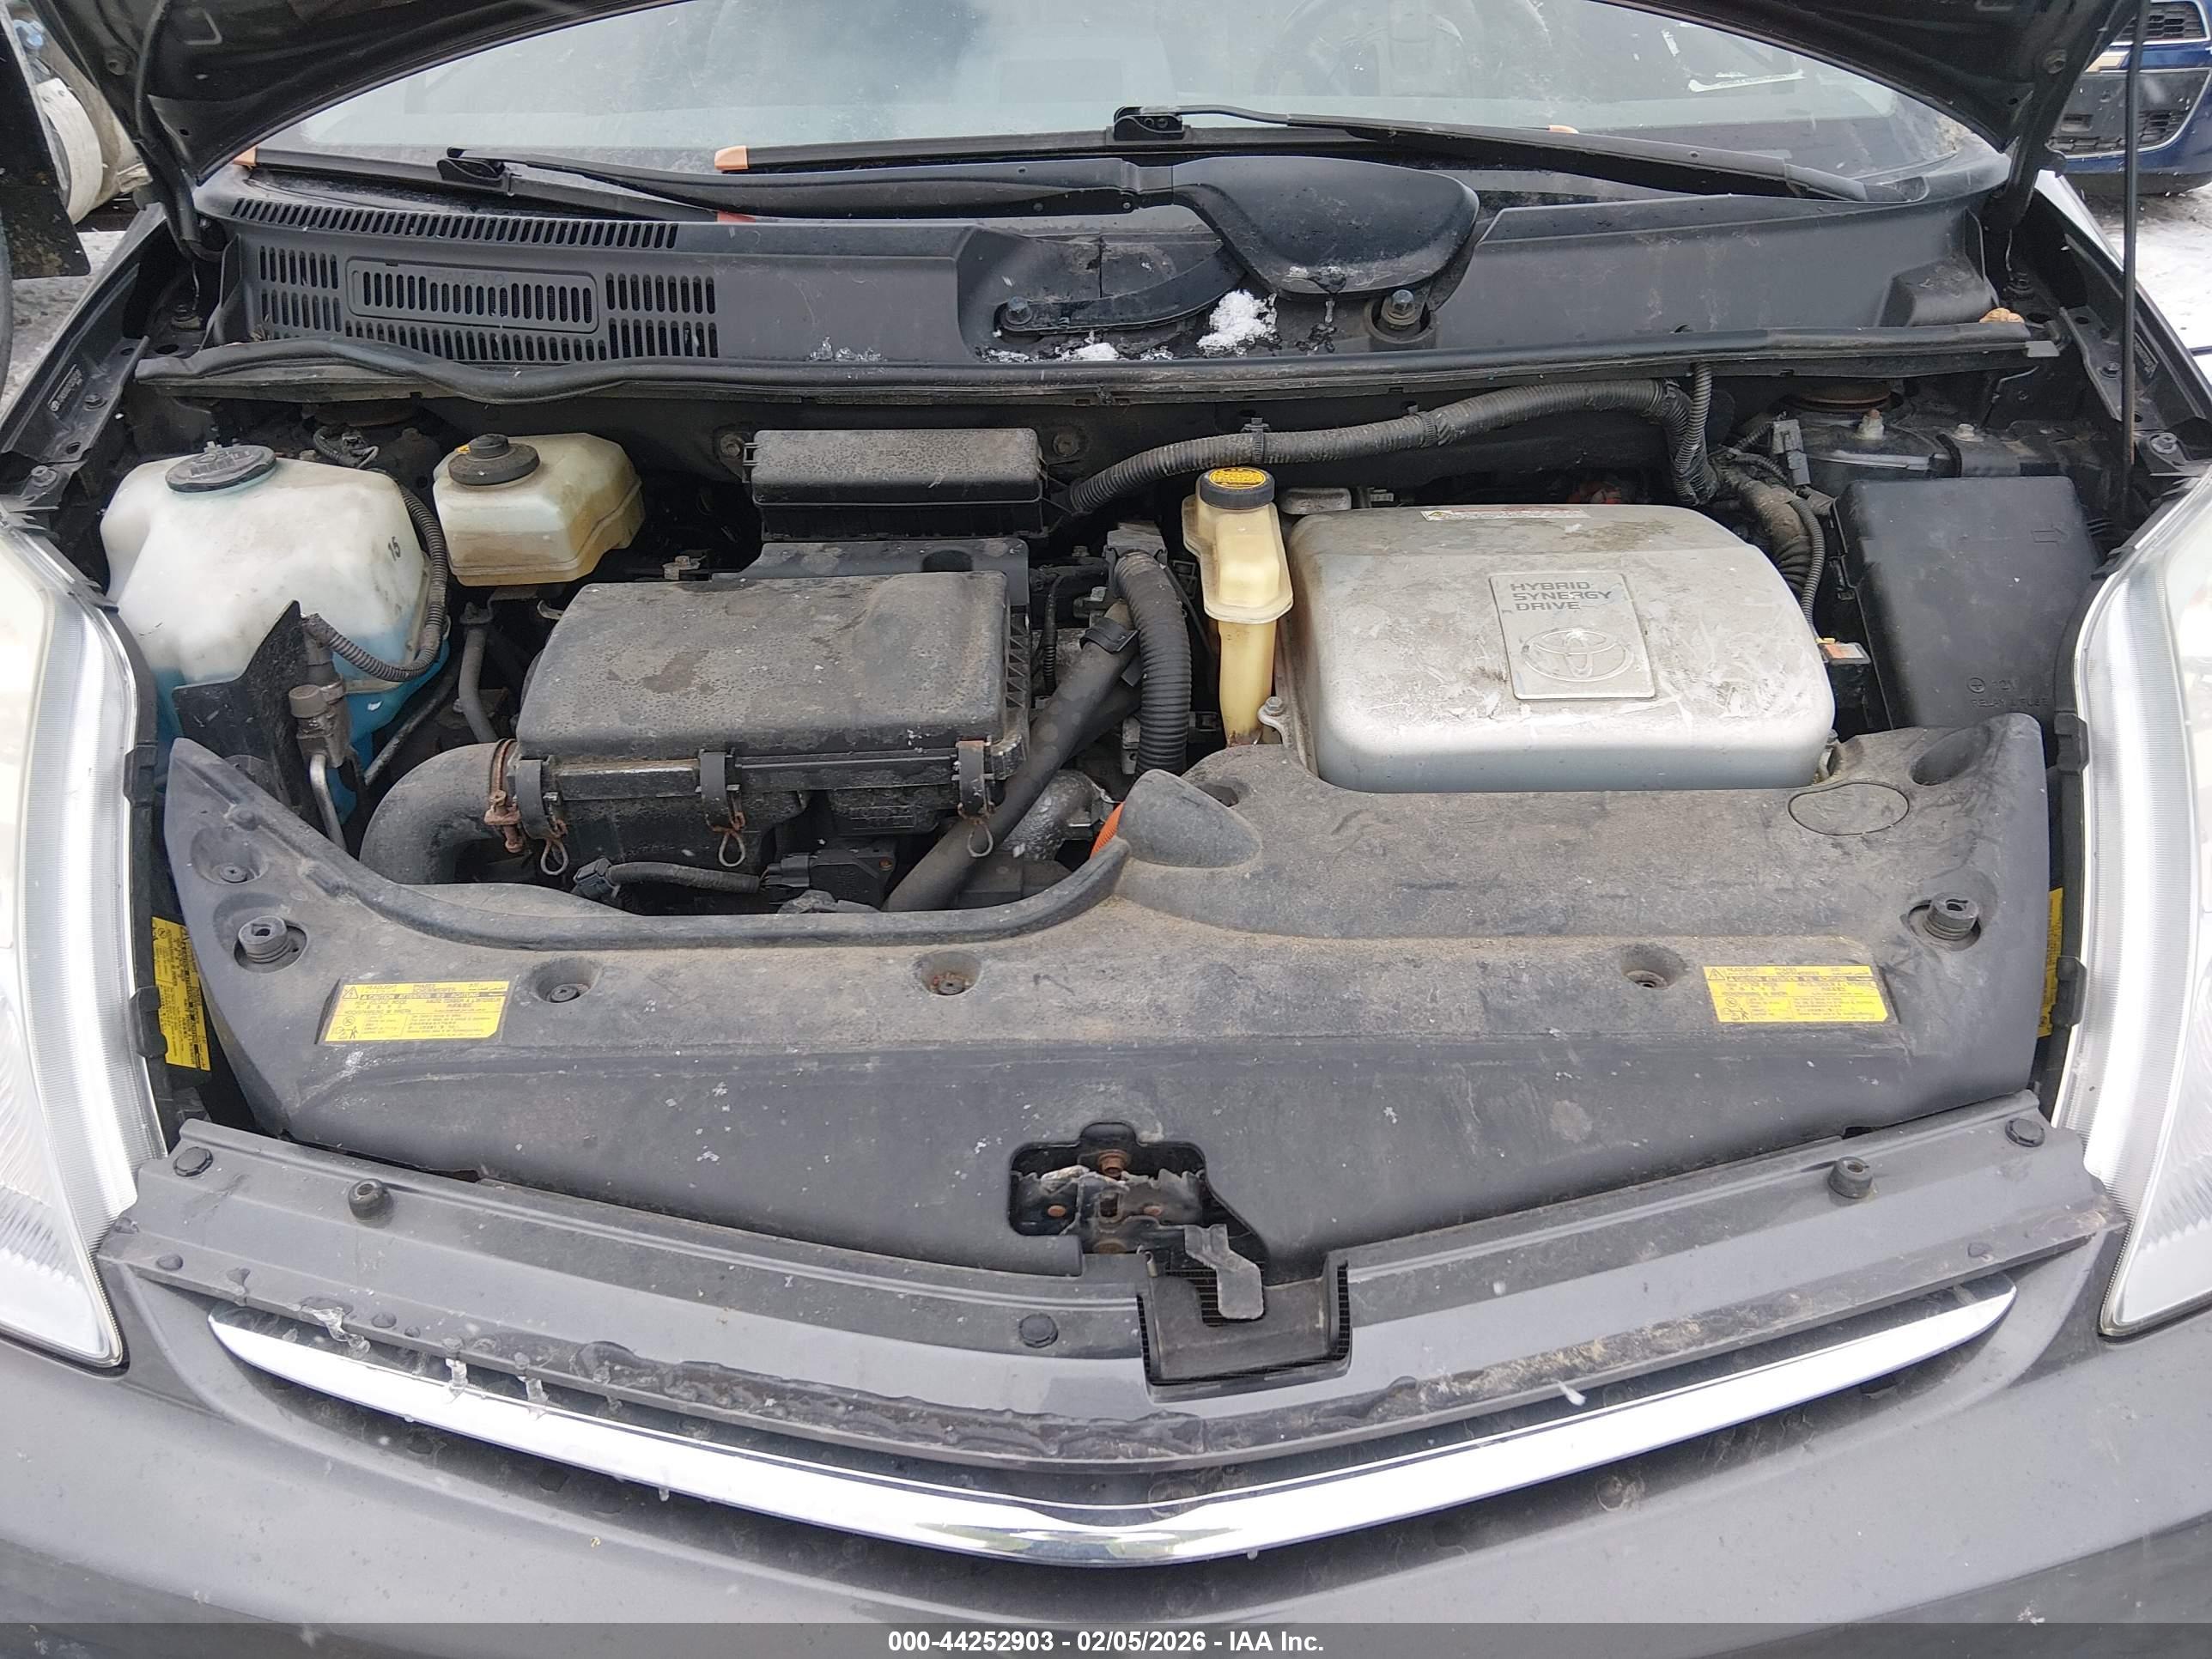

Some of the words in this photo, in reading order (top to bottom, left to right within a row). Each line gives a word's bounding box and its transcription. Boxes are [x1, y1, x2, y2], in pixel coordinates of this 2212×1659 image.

[1510, 581, 1591, 591] HYBRID
[1512, 591, 1612, 600] SYNERGY
[1516, 601, 1581, 611] DRIVE
